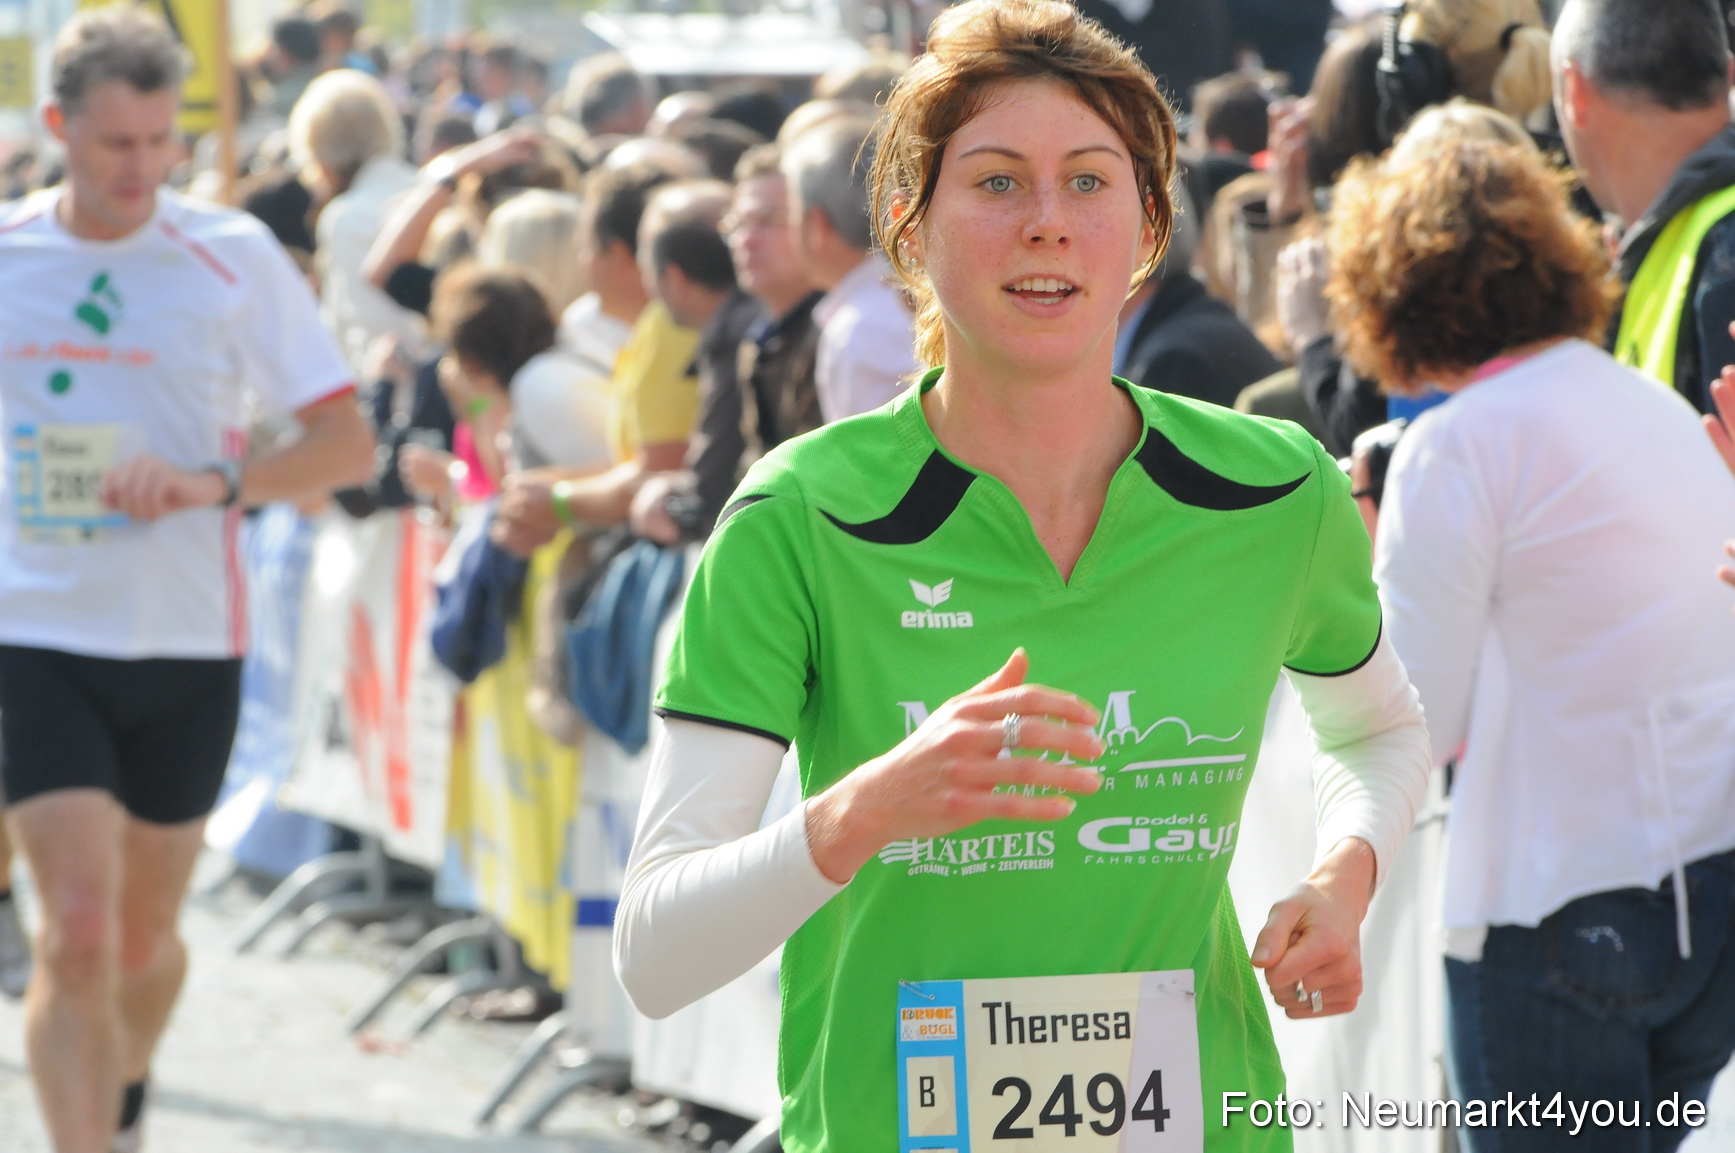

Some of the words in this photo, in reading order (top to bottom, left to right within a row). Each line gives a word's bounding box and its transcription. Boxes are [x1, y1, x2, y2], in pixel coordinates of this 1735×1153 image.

[901, 608, 974, 629] erima
[1135, 767, 1244, 789] MANAGING
[1135, 813, 1194, 826] Dodel
[907, 830, 1056, 866] HÄRTEIS
[908, 861, 950, 877] GETRÄNKE
[961, 862, 988, 876] WEINE
[998, 858, 1054, 872] ZELTVERLEIH
[1085, 853, 1204, 865] FAHRSCHULE
[919, 1023, 956, 1036] BÖGL
[982, 1001, 1131, 1045] Theresa
[919, 1076, 936, 1107] B
[991, 1070, 1171, 1140] 2494
